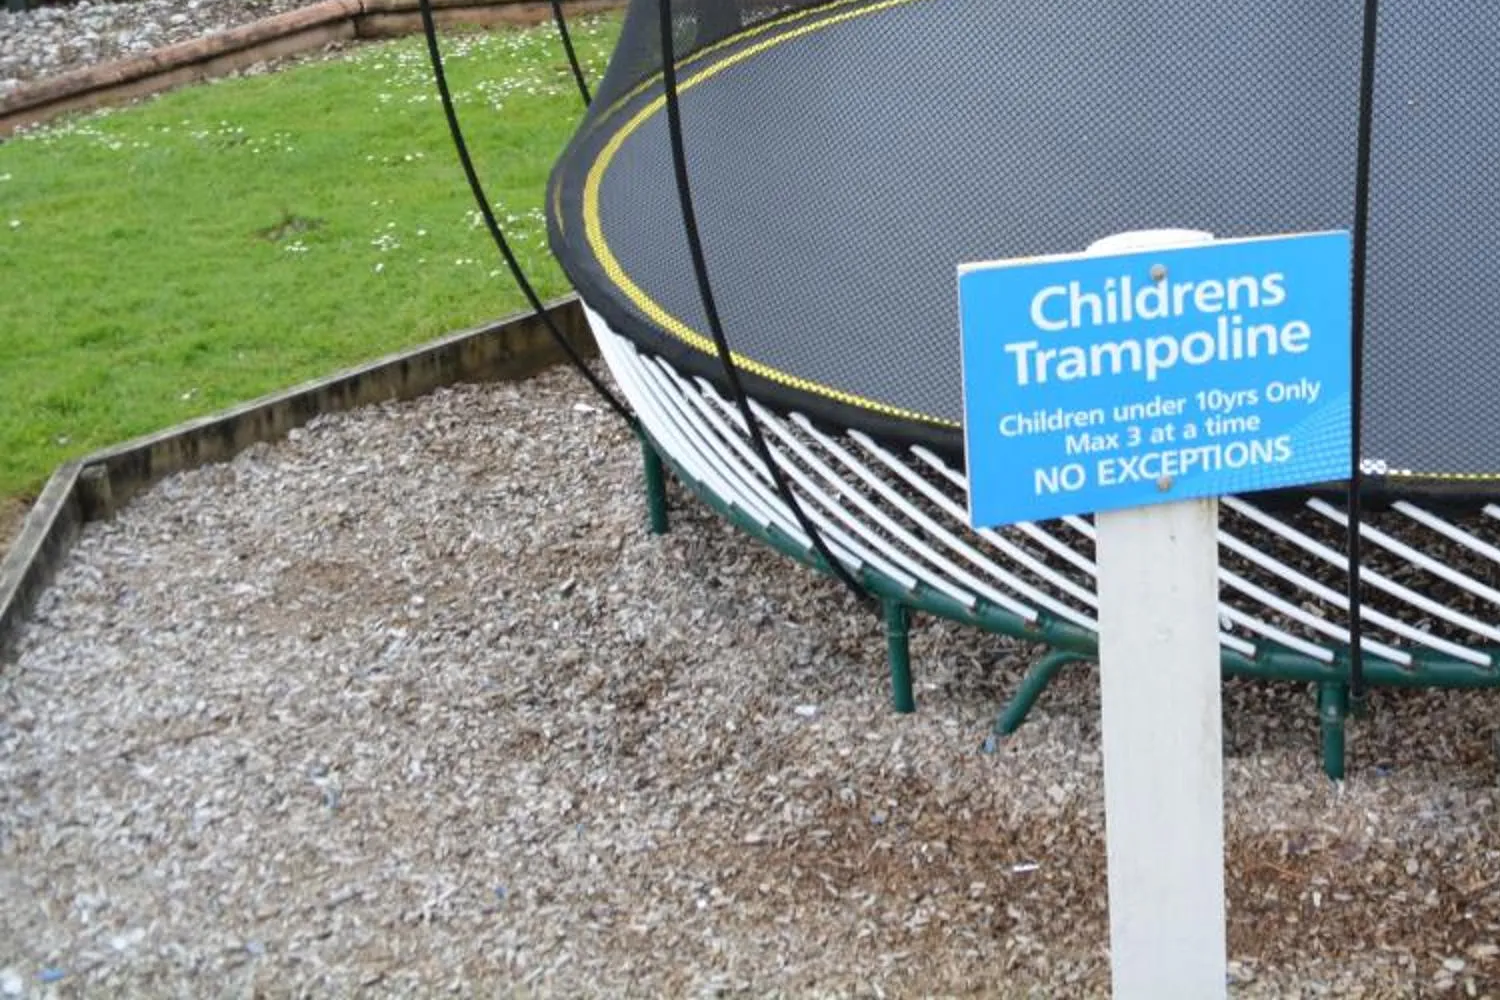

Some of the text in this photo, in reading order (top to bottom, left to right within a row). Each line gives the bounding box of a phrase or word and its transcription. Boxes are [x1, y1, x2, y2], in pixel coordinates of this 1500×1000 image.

[1030, 272, 1286, 331] Childrens
[1005, 315, 1312, 386] Trampoline
[1000, 379, 1321, 437] Children under 10yrs Only
[1066, 414, 1261, 456] Max 3 at a time
[1035, 436, 1292, 495] NO EXCEPTIONS
